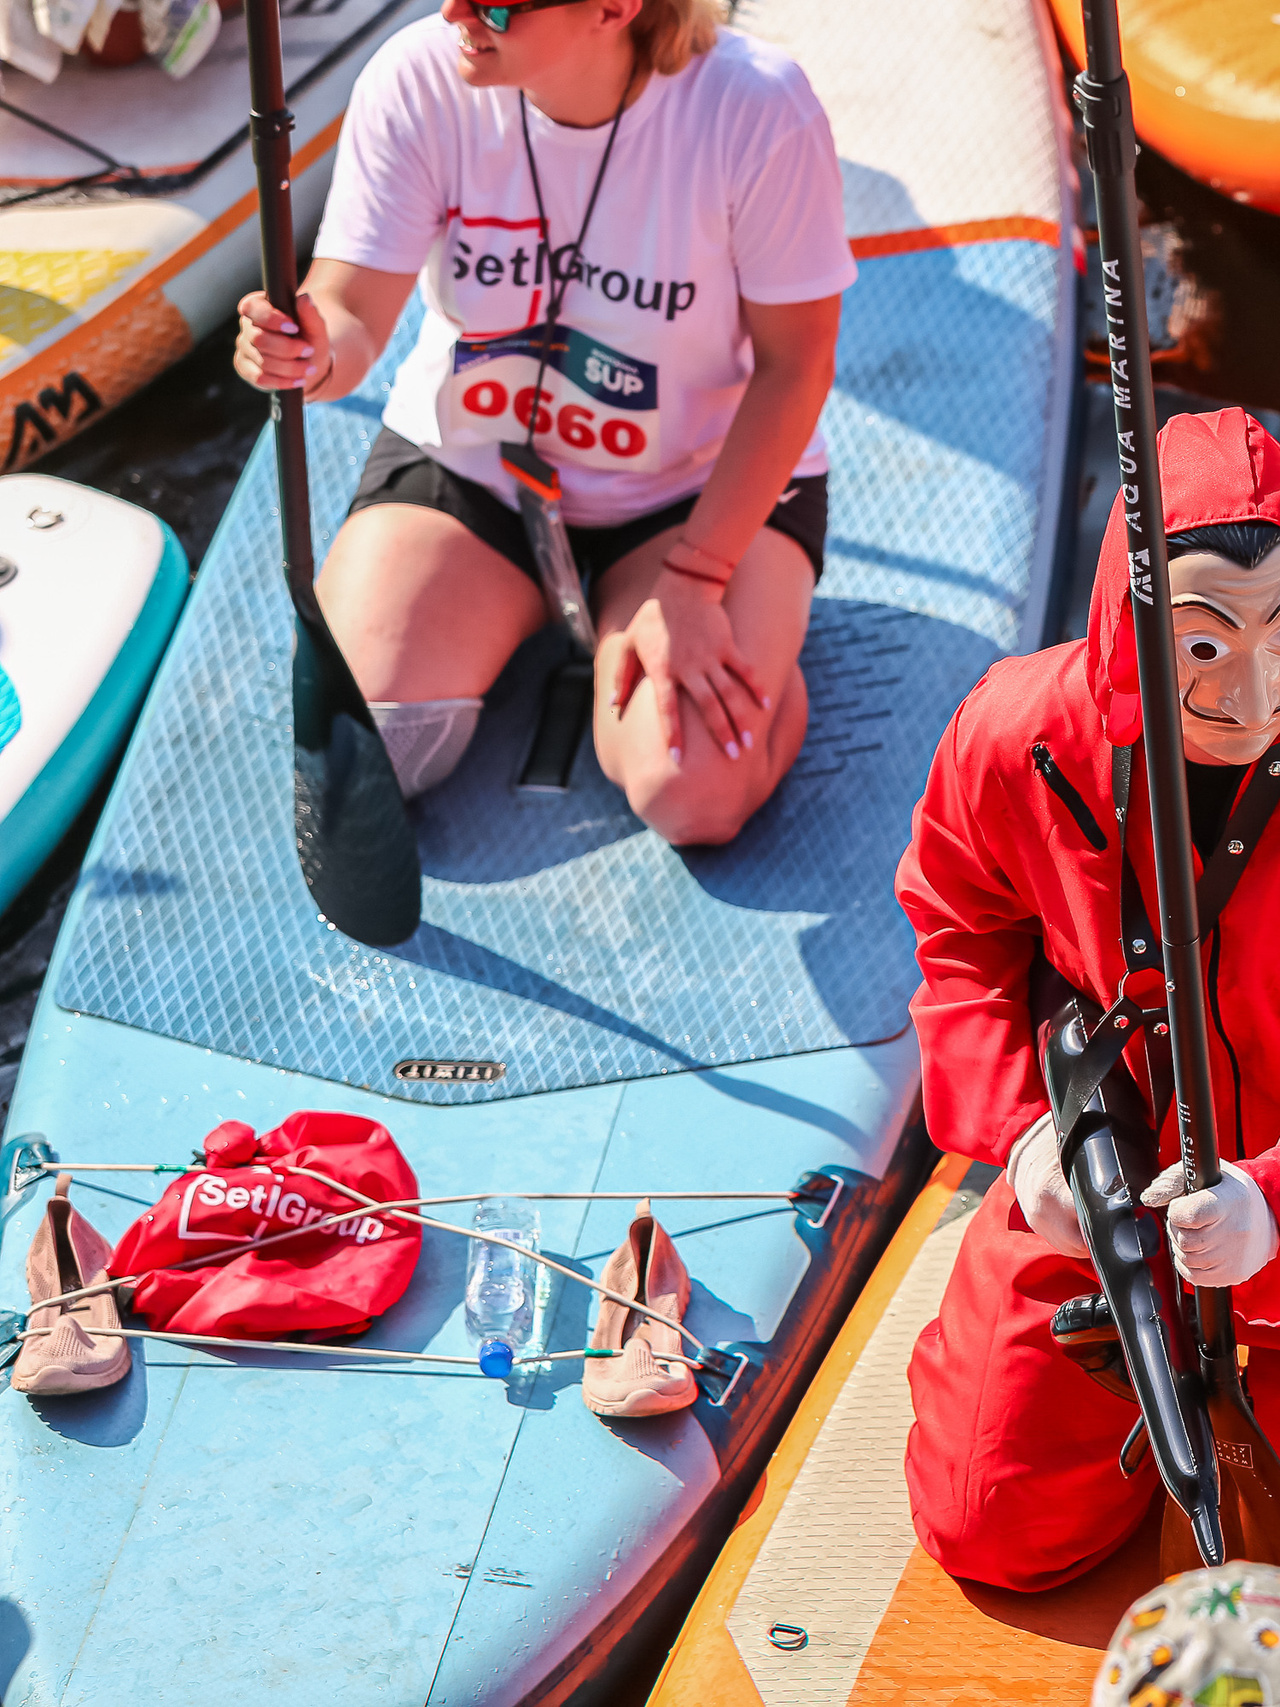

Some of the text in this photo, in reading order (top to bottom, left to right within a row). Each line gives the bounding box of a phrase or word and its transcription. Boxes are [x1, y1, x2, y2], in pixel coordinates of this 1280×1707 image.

[584, 354, 645, 396] SUP
[1102, 258, 1143, 534] AQUA MARINA
[462, 380, 647, 459] 0660
[1181, 1133, 1198, 1192] PORTS
